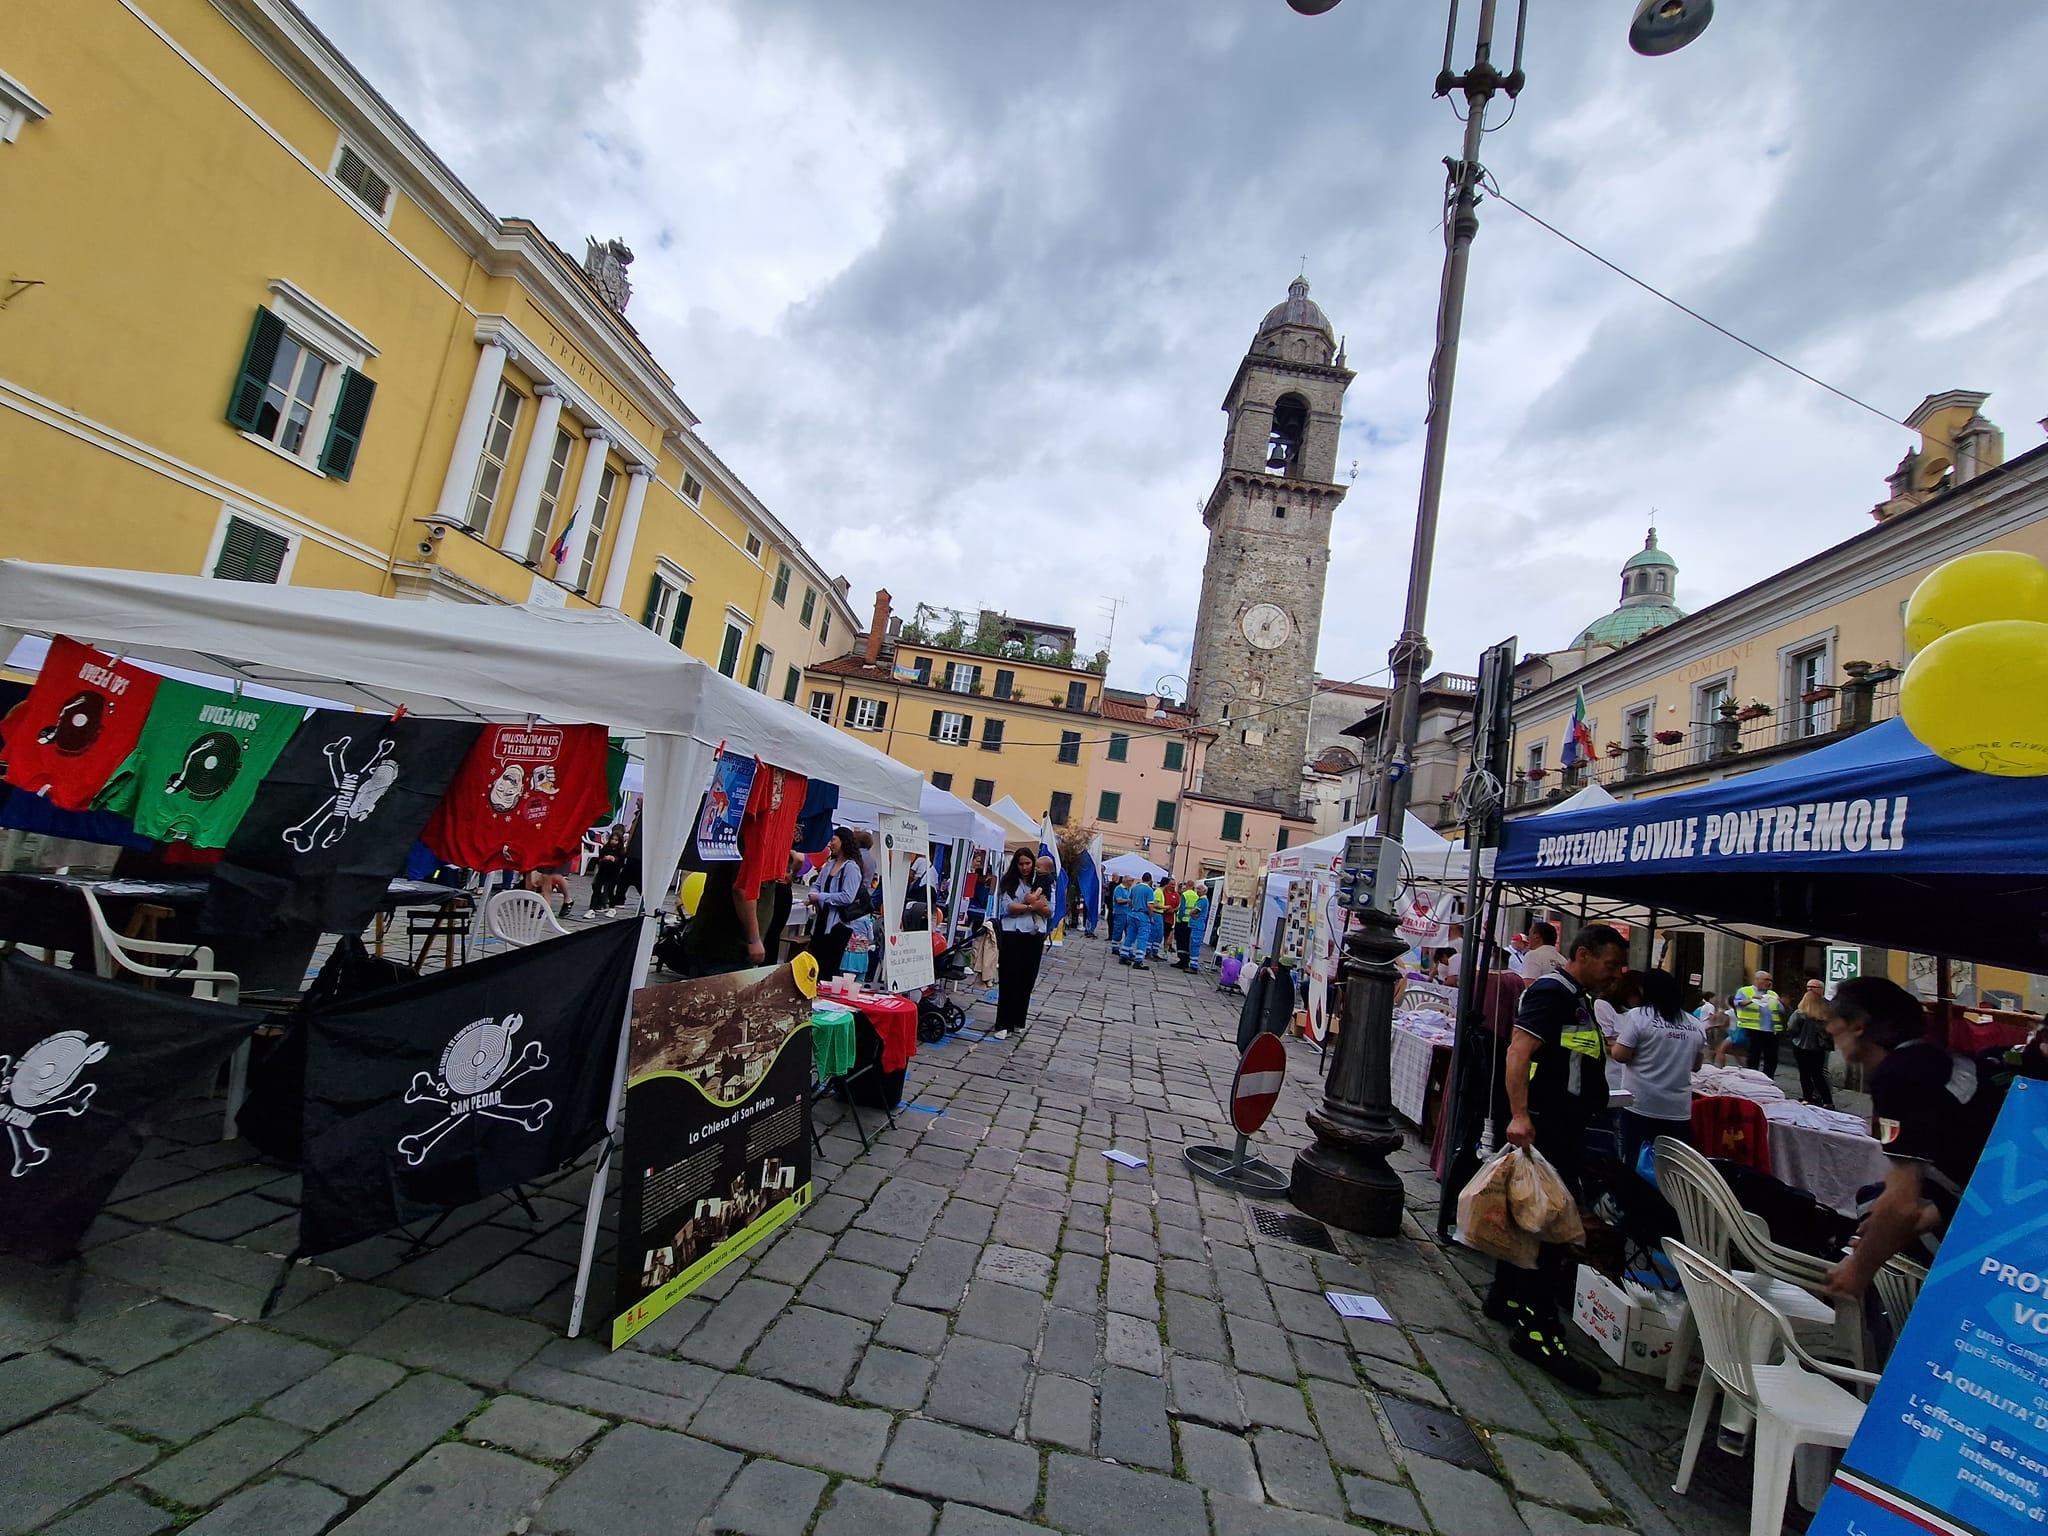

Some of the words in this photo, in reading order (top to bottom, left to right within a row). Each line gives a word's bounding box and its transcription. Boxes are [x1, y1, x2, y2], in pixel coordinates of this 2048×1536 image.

[548, 332, 633, 421] TRIBUNALE
[1678, 641, 1754, 682] COMUNE
[199, 704, 233, 727] PEDAR
[233, 709, 261, 731] SAN
[340, 772, 359, 791] SAN
[333, 790, 355, 817] PEDAR
[1536, 824, 1629, 867] PROTEZIONE
[1630, 816, 1699, 862] CIVILE
[1702, 796, 1909, 857] PONTREMOLI
[450, 1098, 470, 1117] SAN
[470, 1090, 502, 1111] PEDAR
[689, 1132, 700, 1145] La
[701, 1118, 730, 1138] Chiesa
[731, 1111, 740, 1123] di
[740, 1106, 755, 1120] San
[755, 1096, 775, 1113] Pietro
[2014, 1302, 2048, 1335] VO
[1975, 1328, 2004, 1347] una
[1953, 1338, 1989, 1359] quei
[1989, 1354, 2038, 1382] servizi
[1901, 1413, 1944, 1441] degli
[2034, 1413, 2048, 1433] D
[1990, 1439, 2018, 1460] dei
[1959, 1442, 2040, 1498] interventi,
[1957, 1467, 2026, 1511] primario
[2028, 1507, 2047, 1522] di
